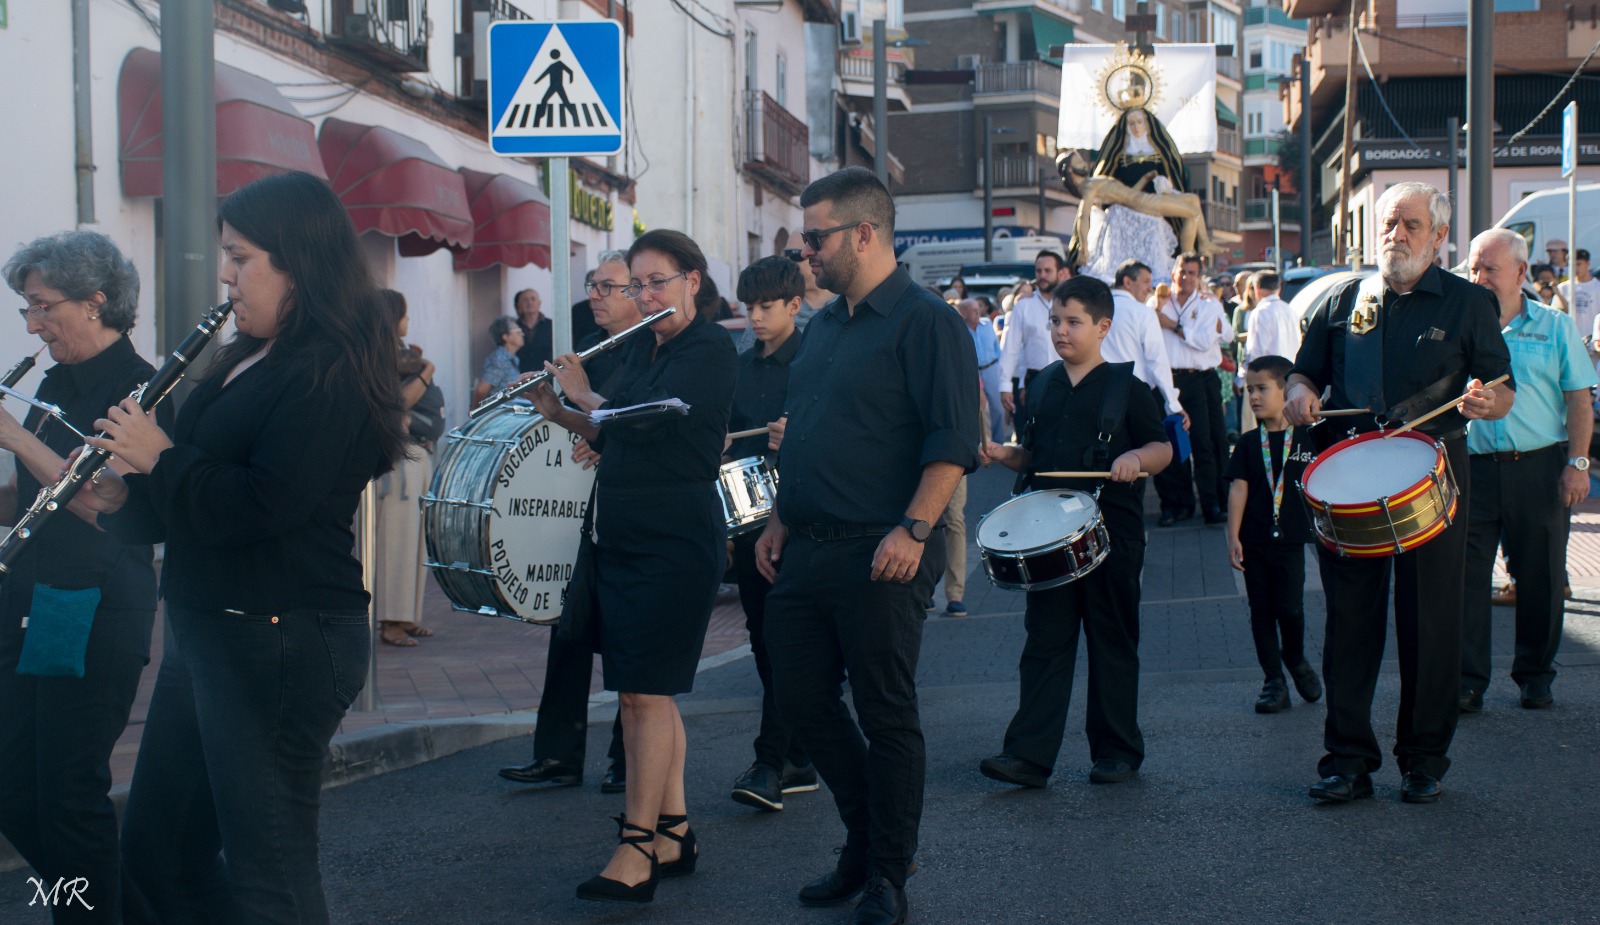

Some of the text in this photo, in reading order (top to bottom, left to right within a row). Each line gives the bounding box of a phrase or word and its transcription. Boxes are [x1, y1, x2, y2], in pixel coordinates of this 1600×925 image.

[1365, 148, 1431, 160] BORDADOS
[1510, 146, 1527, 157] DE
[1529, 145, 1562, 156] ROPA
[894, 235, 940, 249] PTICA
[498, 424, 550, 488] SOCIEDAD
[545, 449, 562, 467] LA
[508, 498, 587, 519] INSEPARABLE
[491, 538, 528, 605] POZUELO
[533, 592, 550, 611] DE
[525, 564, 572, 582] MADRID
